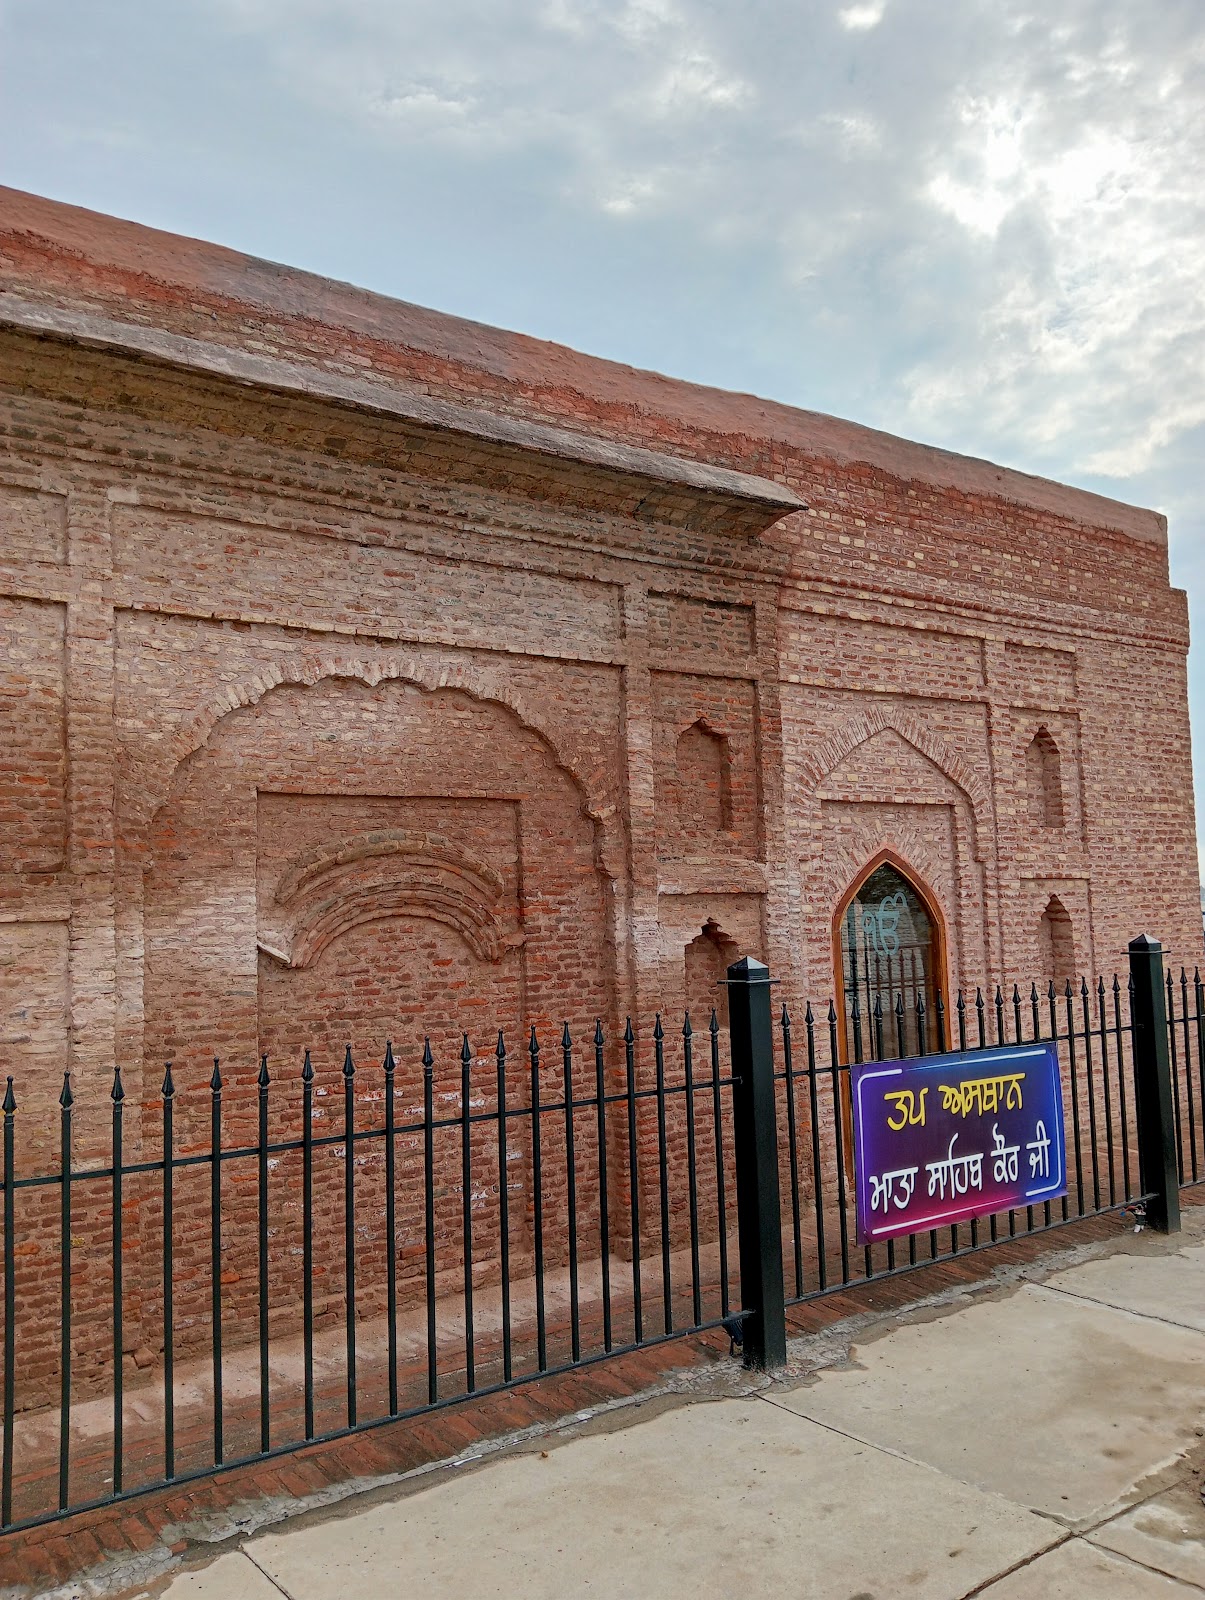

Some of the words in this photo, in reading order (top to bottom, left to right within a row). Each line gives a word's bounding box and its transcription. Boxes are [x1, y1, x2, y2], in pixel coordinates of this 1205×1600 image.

[884, 1087, 928, 1131] ਤਪ
[937, 1072, 1026, 1119] ਅਸਥਾਨ
[868, 1166, 919, 1214] ਮਾਤਾ
[925, 1132, 984, 1200] ਸਾਹਿਬ
[990, 1122, 1021, 1184] ਕੌਰ
[1025, 1119, 1051, 1179] ਜੀ
